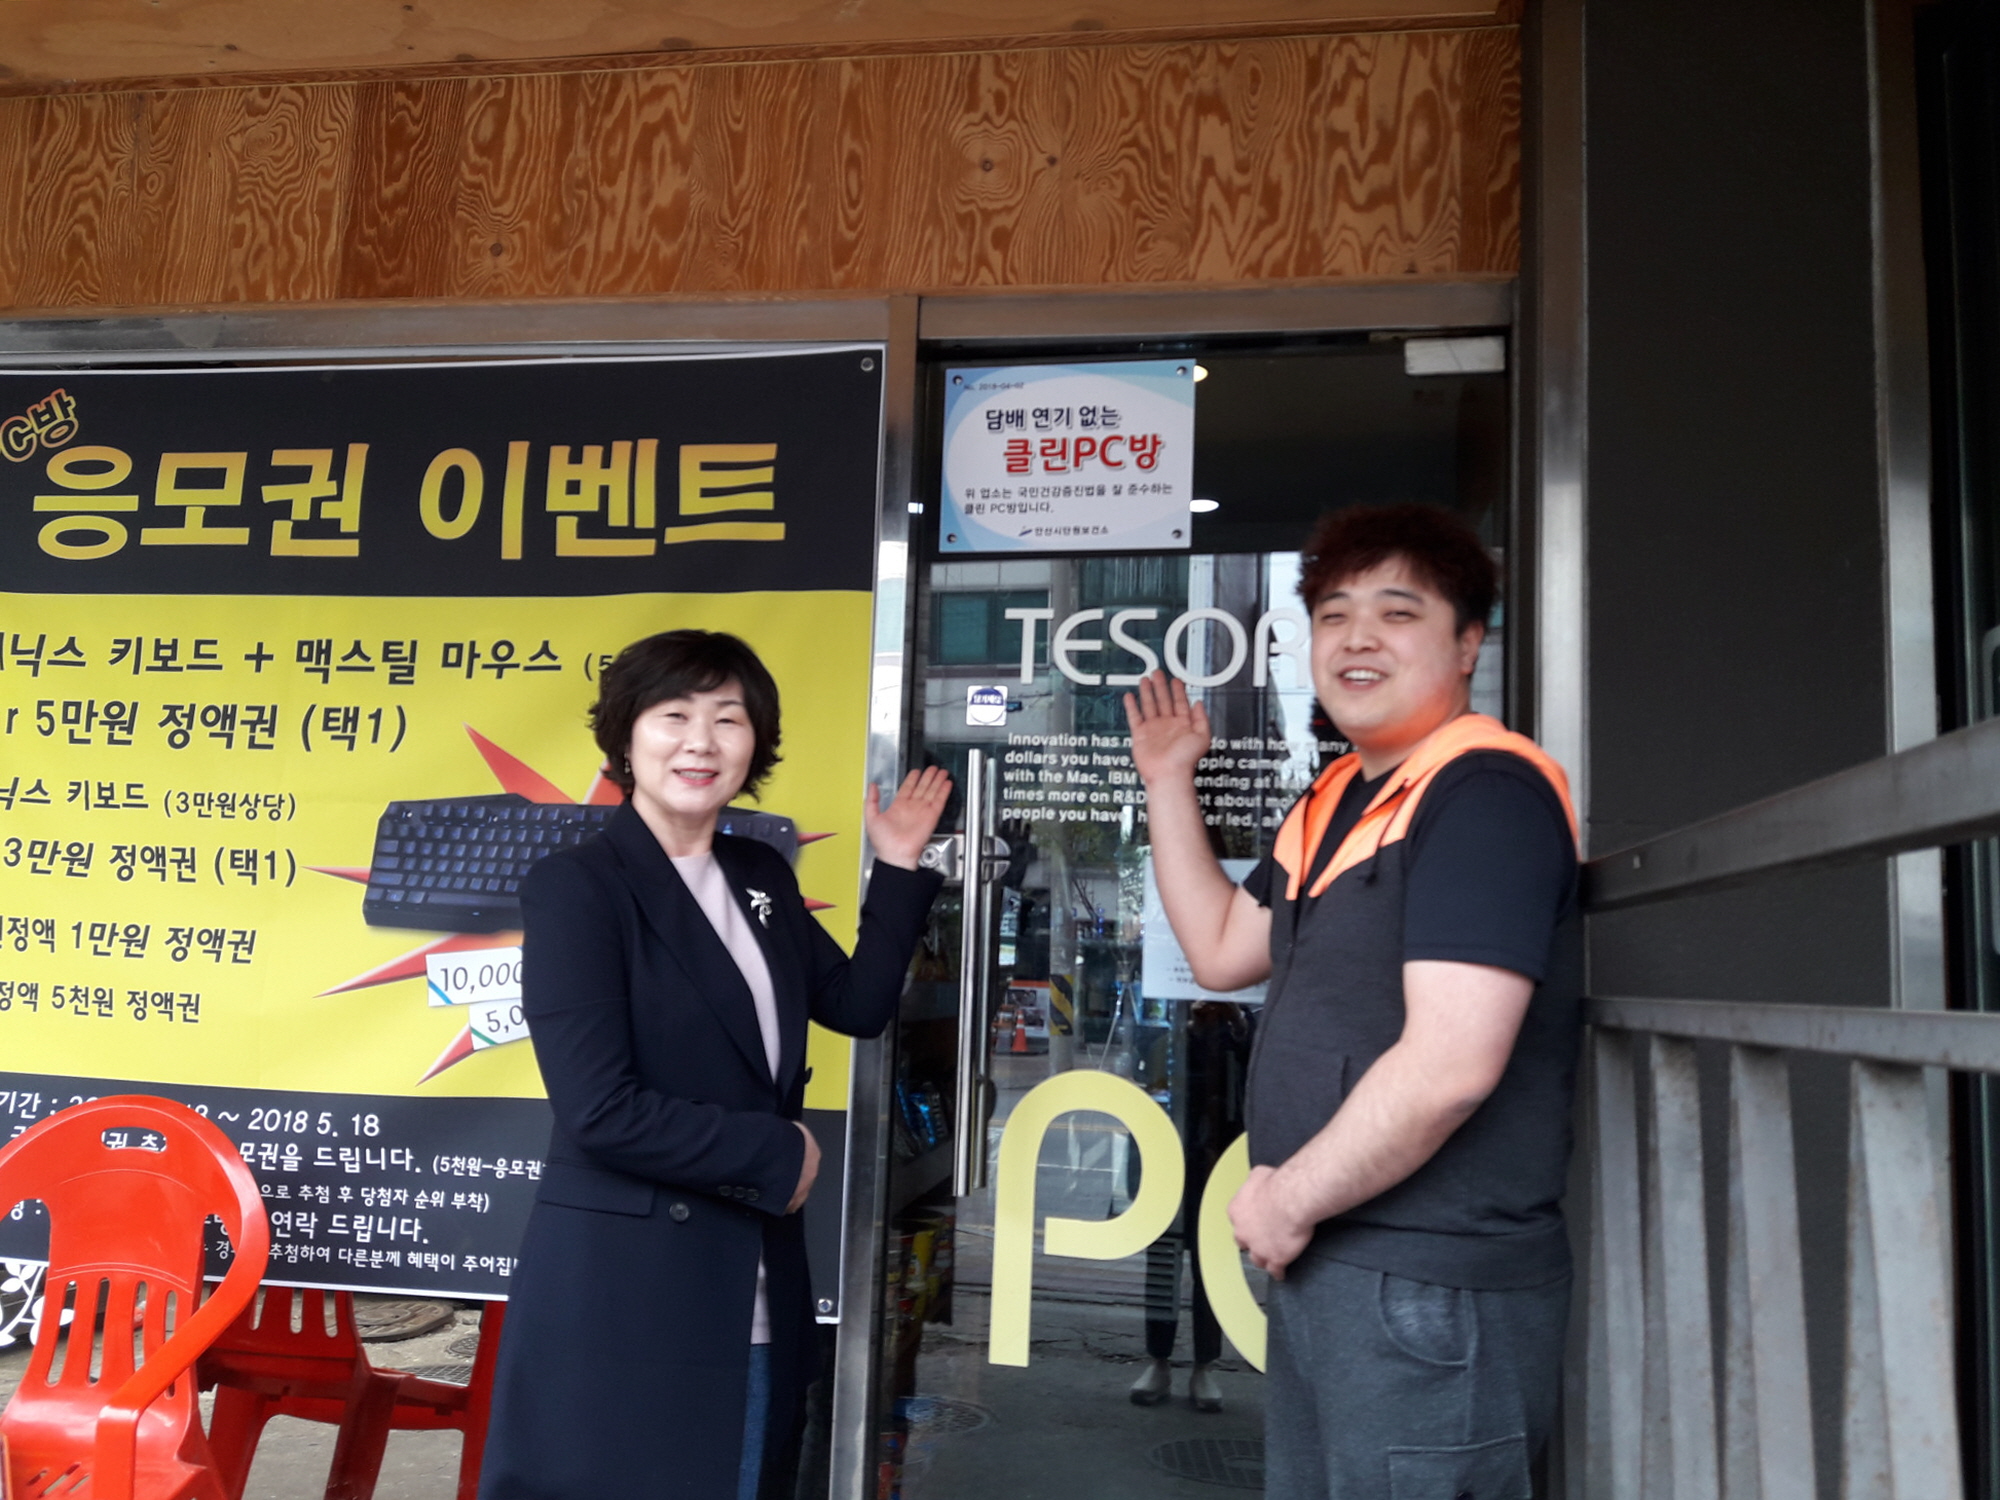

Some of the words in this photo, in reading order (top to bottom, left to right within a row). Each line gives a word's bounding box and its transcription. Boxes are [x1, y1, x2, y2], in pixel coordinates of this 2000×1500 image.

[985, 408, 1025, 431] 담배
[1031, 406, 1071, 429] 연기
[1078, 405, 1120, 428] 없는
[1003, 432, 1164, 475] 클린PC방
[33, 442, 370, 560] 응모권
[418, 438, 786, 561] 이벤트
[980, 487, 1012, 499] 업소는
[1127, 481, 1174, 496] 준수하는
[0, 631, 86, 678] 닉스
[107, 637, 223, 676] 키보드
[295, 638, 418, 686] 맥스틸
[441, 639, 562, 680] 마우스
[1004, 607, 1309, 687] TESOR
[36, 699, 139, 746] 5만원
[157, 702, 278, 750] 정액권
[301, 703, 407, 753] (택1)
[1008, 732, 1088, 748] Innovation
[1091, 733, 1120, 748] has
[1230, 737, 1264, 751] with
[1004, 750, 1058, 765] dollars
[1061, 755, 1089, 768] you
[1195, 754, 1236, 771] pple
[1003, 768, 1035, 783] with
[1039, 769, 1063, 783] the
[1107, 770, 1138, 785] IBM
[1193, 773, 1250, 791] ending
[1003, 786, 1045, 802] times
[1047, 789, 1088, 803] more
[1089, 791, 1109, 804] on
[1214, 795, 1263, 808] about
[67, 779, 149, 811] 키보드
[163, 789, 297, 822] (3만원상당)
[1002, 806, 1056, 821] people
[1059, 808, 1088, 823] you
[3, 837, 95, 878] 3만원
[109, 844, 197, 883] 정액권
[214, 846, 297, 888] (택1)
[0, 915, 56, 953] 정액
[71, 921, 151, 959] 1만원
[164, 926, 257, 964] 정액권
[51, 984, 114, 1018] 5천원
[126, 989, 201, 1024] 정액권
[0, 1090, 42, 1119] 기간
[247, 1107, 309, 1134] 2018
[316, 1112, 338, 1138] 5.
[351, 1113, 380, 1138] 18
[313, 1146, 422, 1174] 드립니다.
[432, 1154, 547, 1181] (5천원-응모권
[260, 1183, 292, 1200] 으로
[298, 1184, 330, 1205] 추첨
[337, 1185, 354, 1204] 후
[360, 1186, 409, 1209] 당첨자
[414, 1189, 446, 1210] 순위
[450, 1192, 490, 1214] 부착)
[270, 1210, 319, 1240] 연락
[327, 1214, 429, 1245] 드립니다.
[215, 1240, 235, 1260] 경
[268, 1242, 331, 1264] 추첨하여
[338, 1246, 401, 1270] 다른분께
[407, 1251, 455, 1273] 혜택이
[462, 1254, 518, 1277] 주어집
